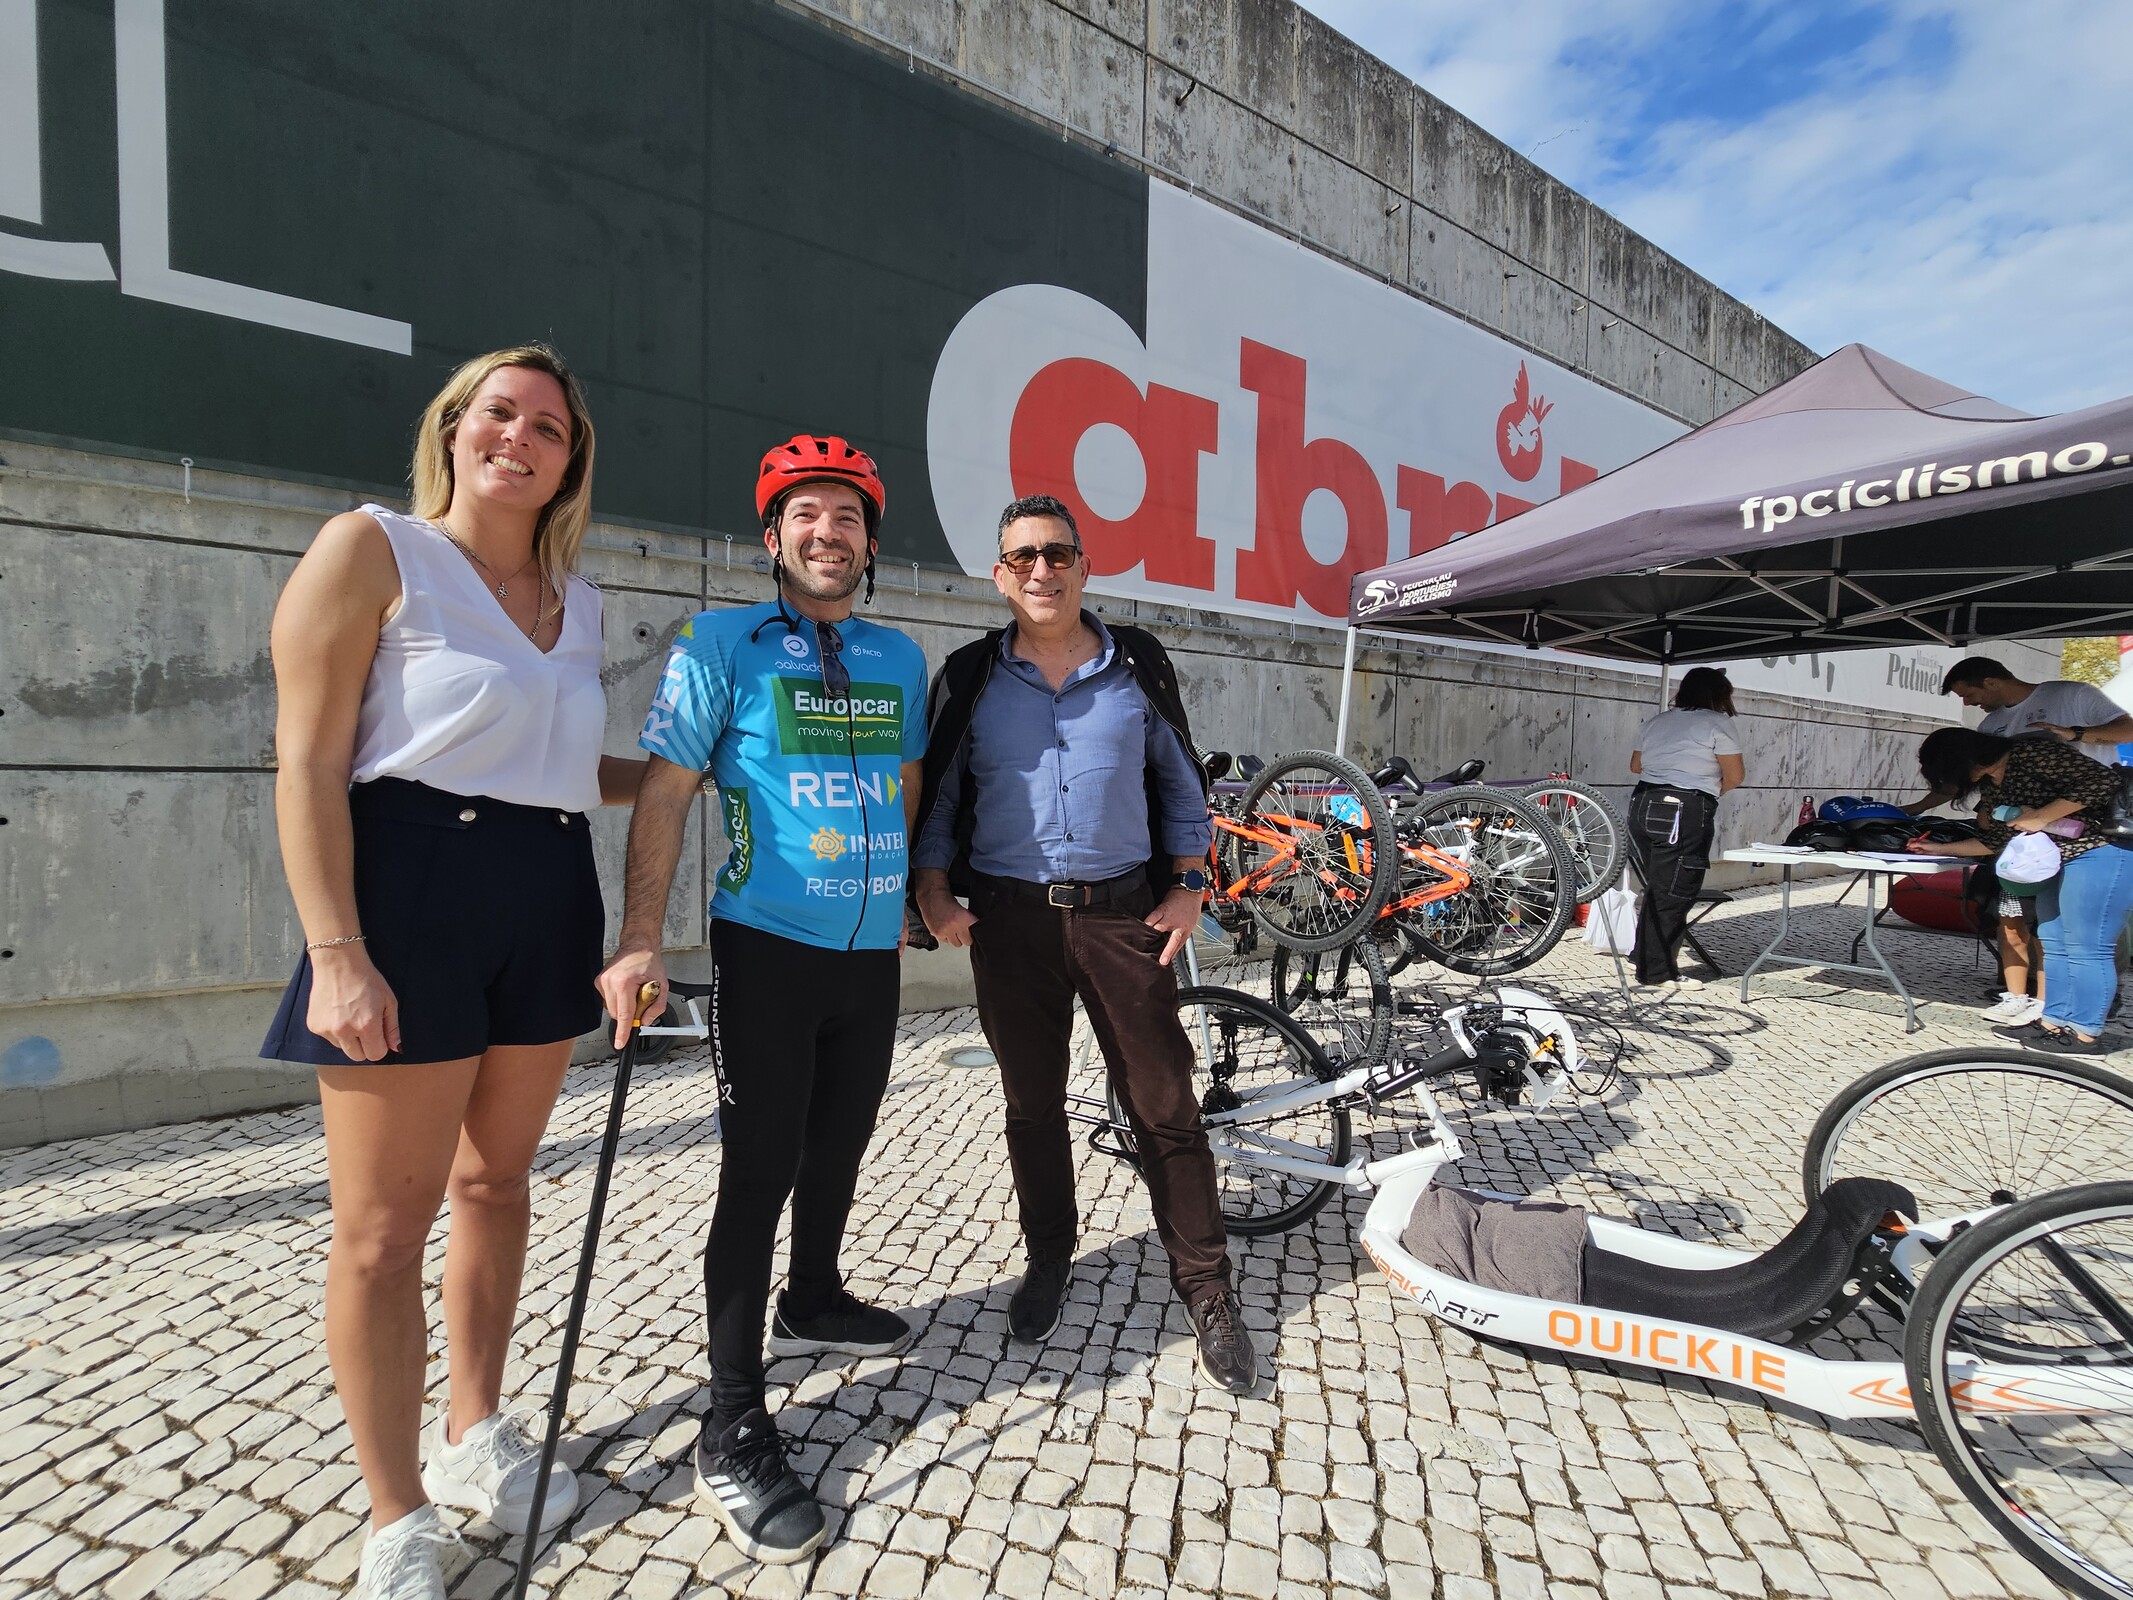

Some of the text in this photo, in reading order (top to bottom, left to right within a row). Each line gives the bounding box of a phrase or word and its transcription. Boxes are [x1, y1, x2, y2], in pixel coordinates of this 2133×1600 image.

[1009, 336, 1598, 618] abri
[1739, 441, 2131, 533] fpciclismo.
[1399, 588, 1452, 608] DE CICLISMO
[1402, 579, 1458, 601] PORTUGUESA
[862, 648, 882, 658] PACTO
[1886, 652, 1950, 697] Palmel
[794, 690, 898, 721] Europcar
[798, 727, 900, 741] moving your way
[789, 771, 883, 807] REN
[850, 831, 904, 854] INATEL
[806, 872, 903, 897] REGYBOX
[712, 964, 726, 1080] GRUNDFOS
[1548, 1310, 1786, 1394] QUICKIE
